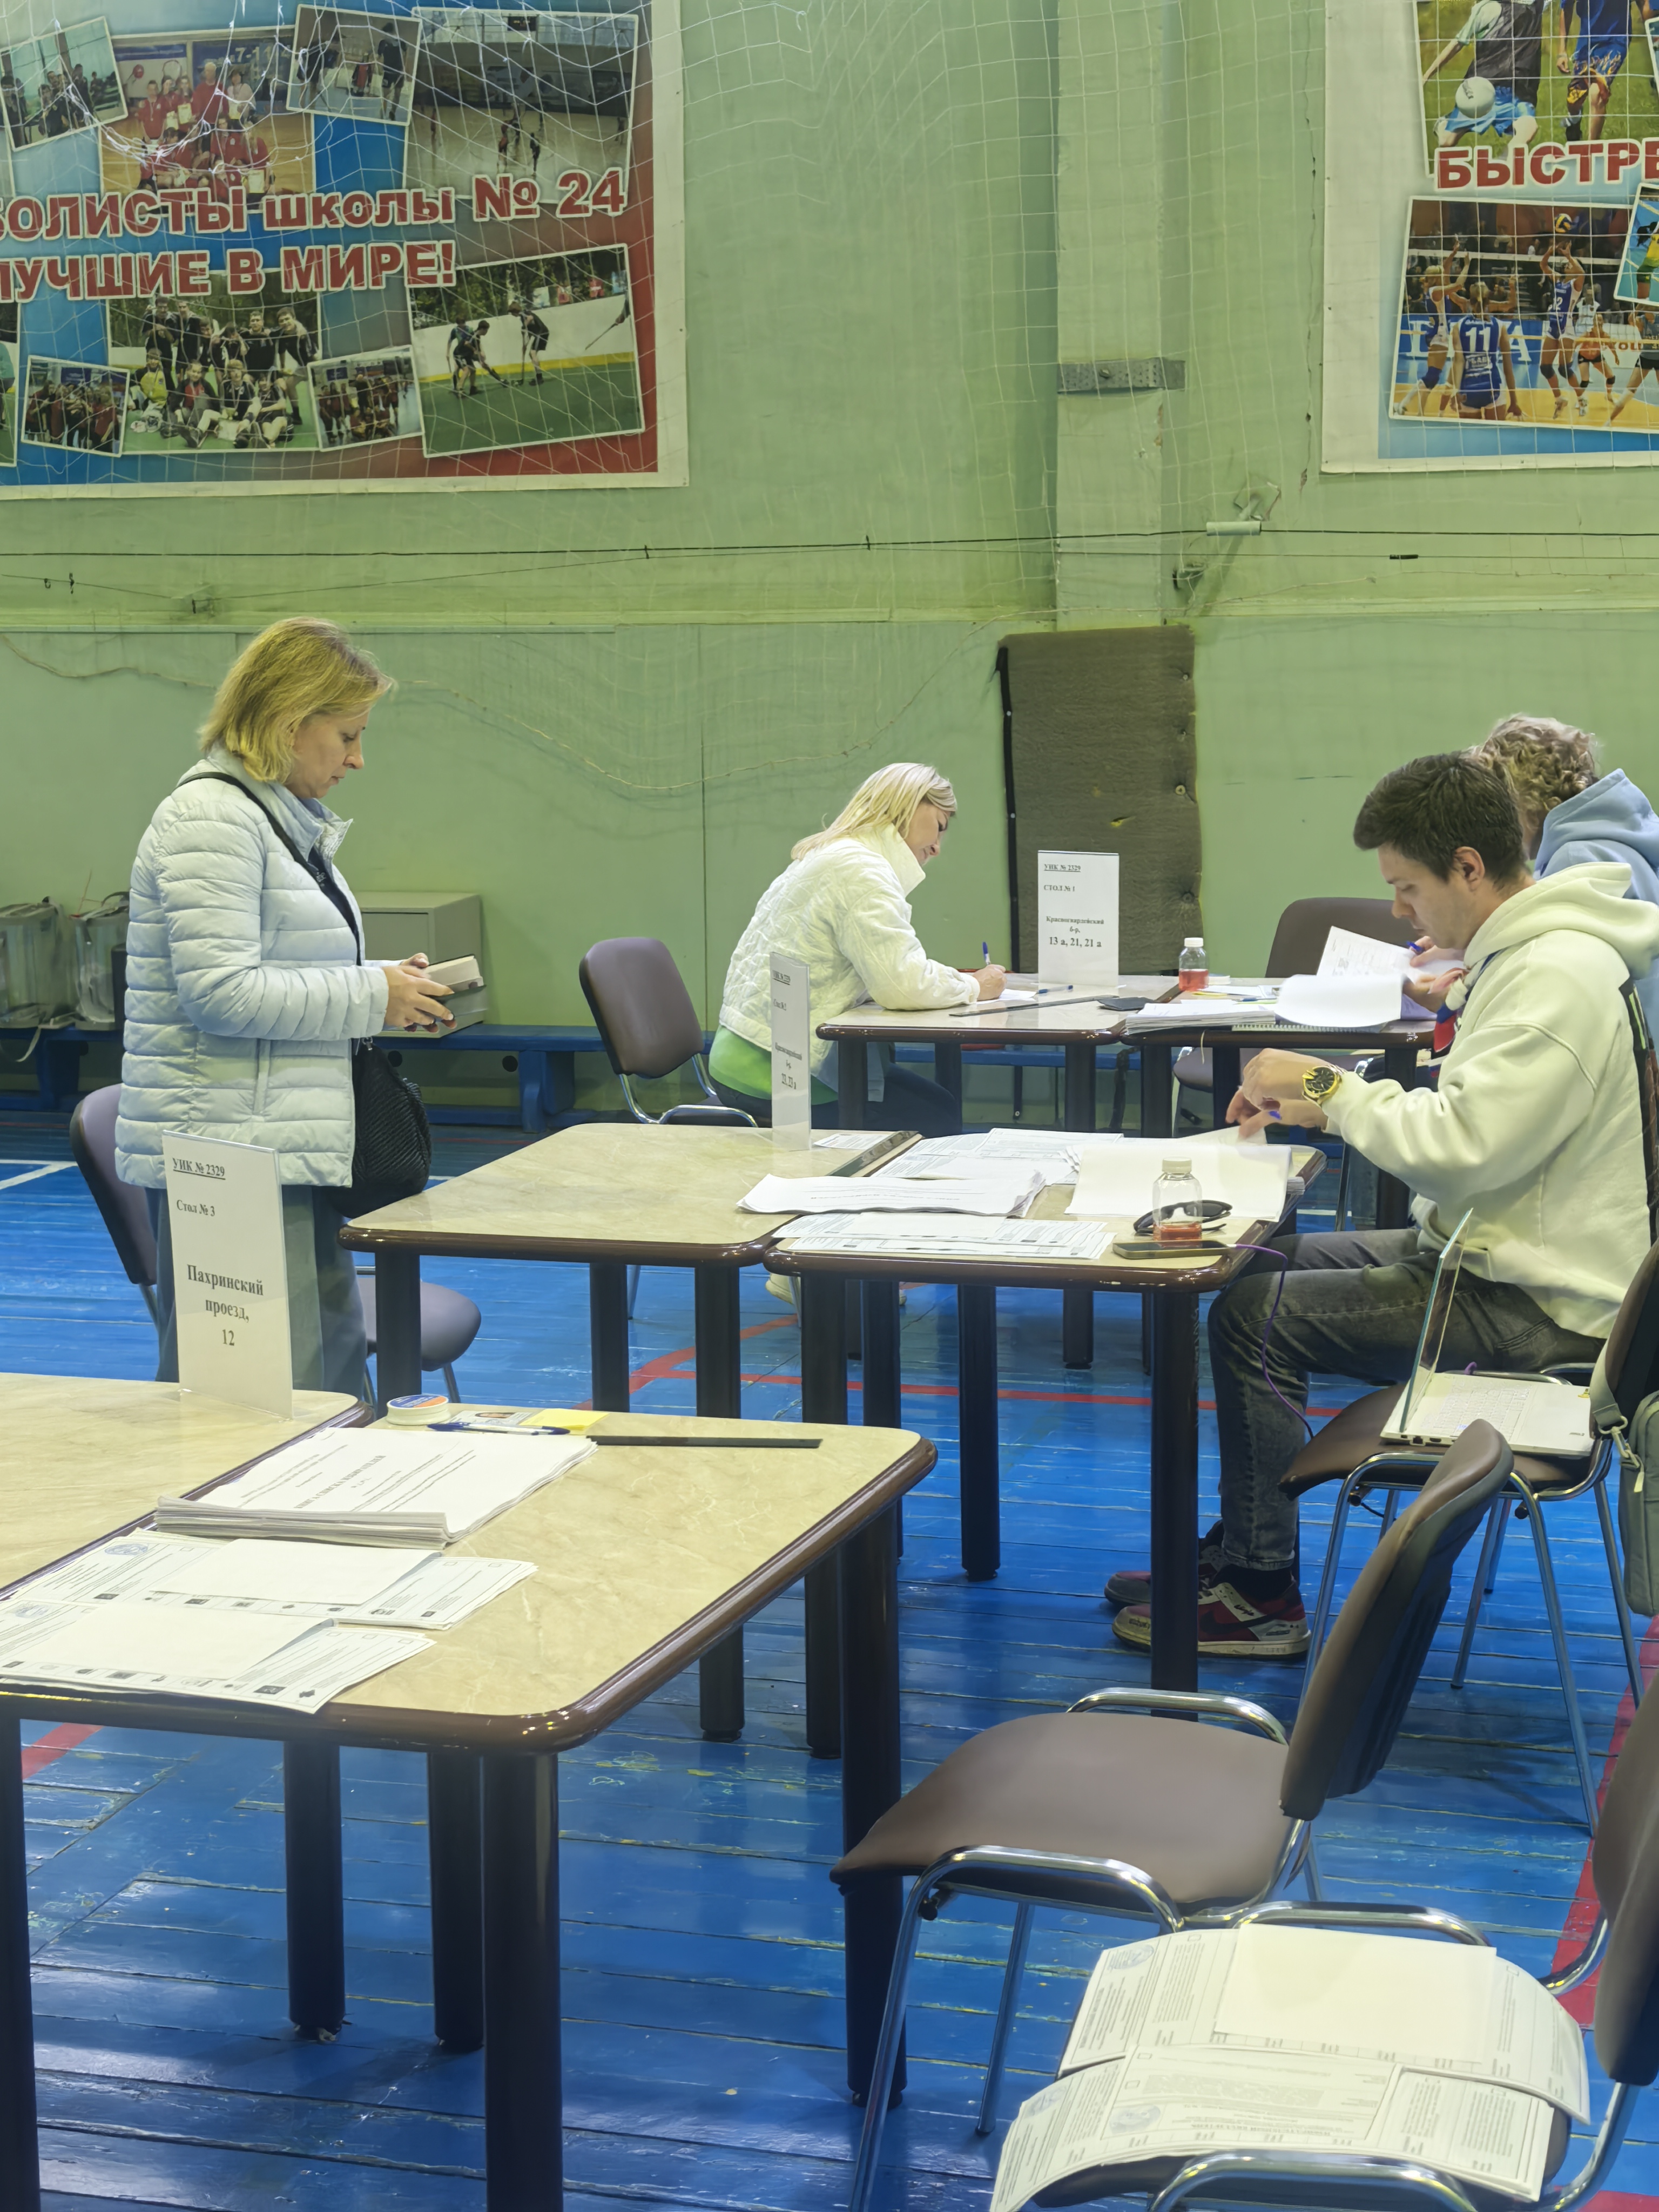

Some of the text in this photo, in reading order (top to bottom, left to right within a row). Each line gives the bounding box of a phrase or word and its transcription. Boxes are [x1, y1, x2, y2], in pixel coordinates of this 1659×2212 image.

[0, 187, 247, 240] ОЛИСТЫ
[474, 174, 539, 219] №
[557, 169, 625, 216] 24
[228, 249, 264, 293] В
[282, 241, 454, 291] МИРЕ!
[1465, 327, 1492, 353] 11
[1049, 936, 1058, 945] 13
[1084, 939, 1094, 947] 21
[172, 1157, 225, 1177] УИК № 2329
[177, 1199, 215, 1217] Стол № 3
[187, 1264, 264, 1296] Пахринский
[205, 1299, 249, 1323] проезд,
[222, 1328, 235, 1346] 12
